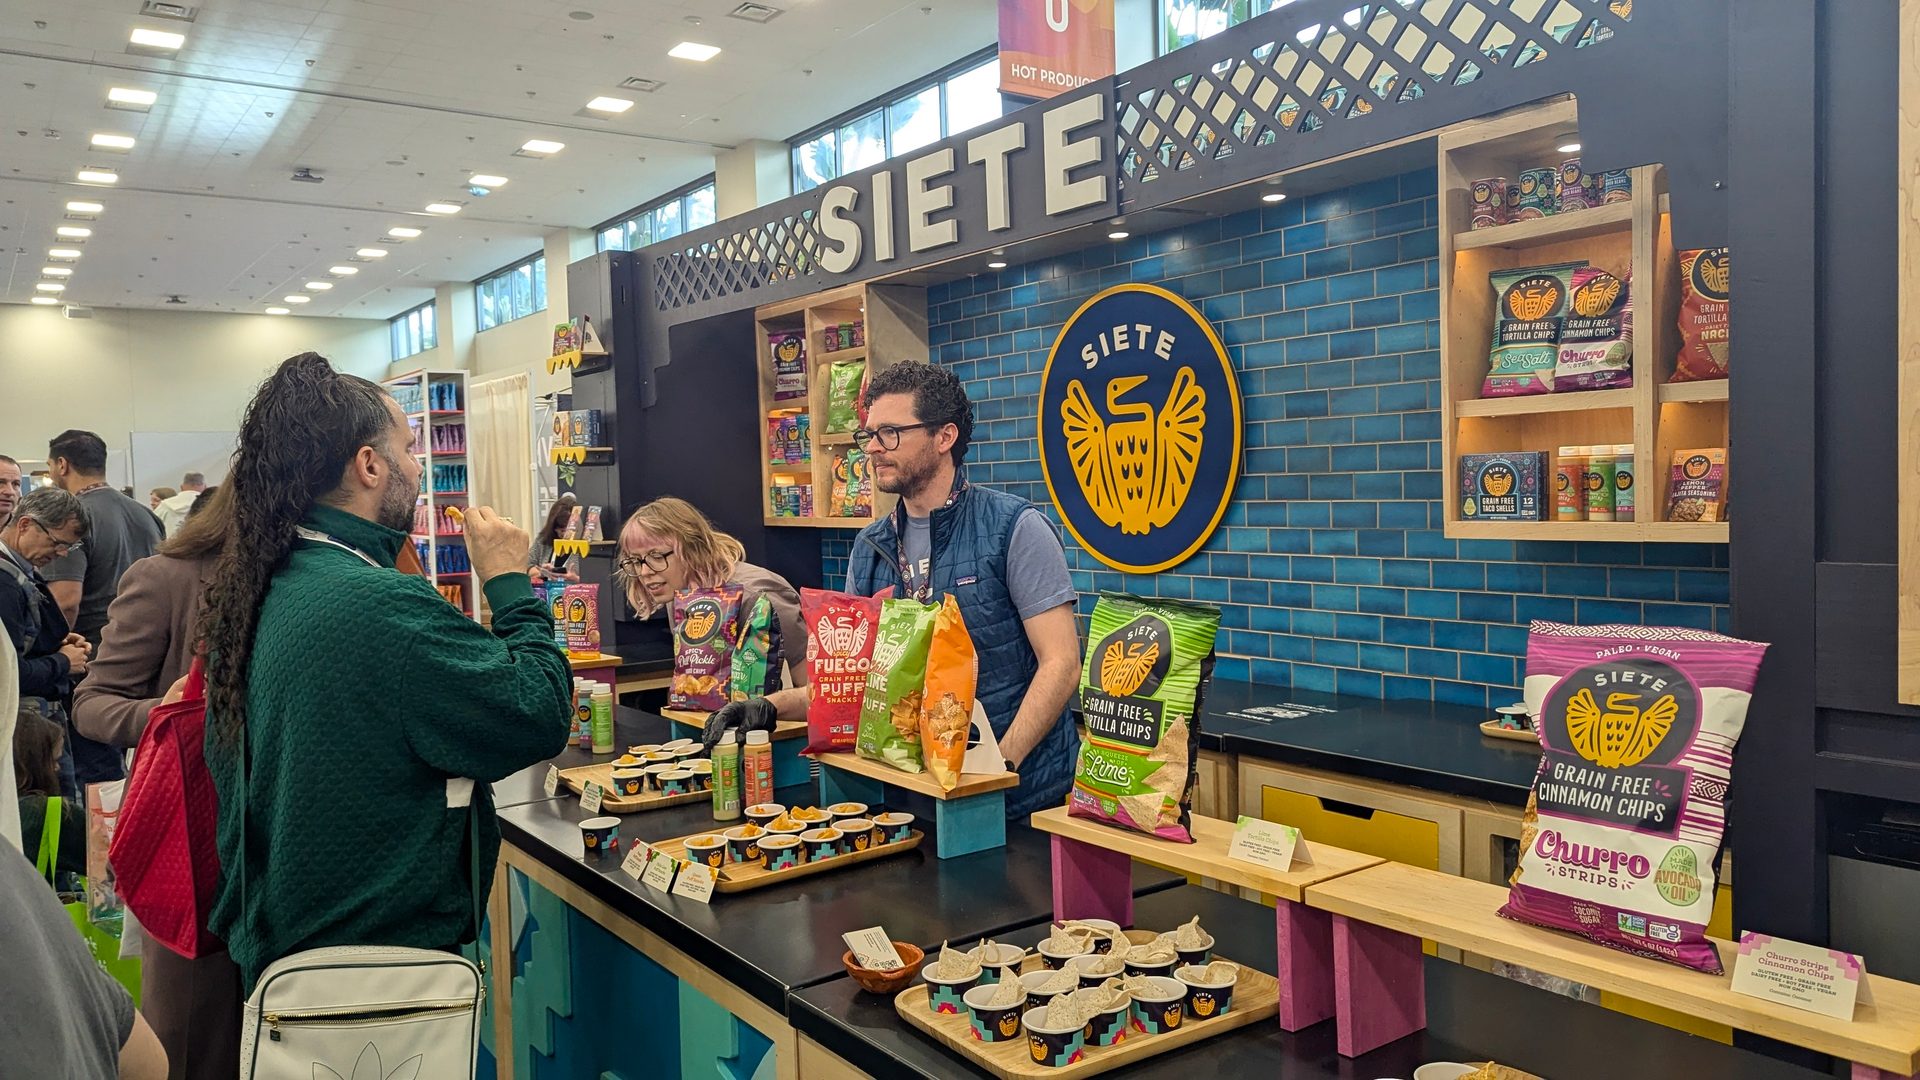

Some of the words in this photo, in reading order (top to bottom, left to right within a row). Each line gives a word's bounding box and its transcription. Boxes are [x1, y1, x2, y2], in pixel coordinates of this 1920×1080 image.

[1011, 63, 1037, 80] HOT
[1040, 69, 1097, 88] PRODUC
[819, 93, 1107, 274] SIETE
[1520, 280, 1551, 288] SIETE
[1700, 304, 1724, 312] GRAIN
[1568, 320, 1590, 328] GRAIN
[1592, 318, 1610, 328] FREE
[1694, 313, 1728, 324] TORTILLA
[1508, 324, 1529, 332] GRAIN
[1532, 322, 1549, 330] FREE
[1562, 329, 1592, 338] CINNAMON
[1594, 328, 1616, 336] CHIPS
[1502, 331, 1531, 342] TORTILLA
[1534, 330, 1555, 339] CHIPS
[1081, 323, 1176, 370] SIETE
[1560, 350, 1606, 364] Churro
[828, 606, 863, 618] STE
[1127, 626, 1158, 641] SIETE
[684, 648, 704, 656] SPICY
[1596, 644, 1633, 659] PALEO
[1644, 645, 1681, 660] VEGAN
[690, 654, 716, 668] Pickle
[814, 658, 871, 674] FUEGO
[820, 682, 866, 697] PUFF
[1594, 671, 1668, 692] SIETE
[1089, 698, 1115, 716] GRAIN
[1118, 702, 1142, 721] FREE
[1086, 713, 1116, 734] ORTILLA
[1120, 720, 1152, 740] CHIPS
[1086, 756, 1130, 786] Lime
[1554, 762, 1607, 788] GRAIN
[1611, 774, 1652, 796] FREE
[1539, 782, 1615, 811] CINNAMON
[1618, 798, 1666, 823] CHIPS
[1534, 829, 1651, 879] Churro
[1669, 856, 1693, 866] MADE
[1670, 864, 1691, 872] WITH
[1558, 866, 1618, 888] STRIPS
[1653, 870, 1702, 892] AVOCADO
[1670, 886, 1686, 902] OIL
[1574, 906, 1601, 918] COCONUT
[1578, 915, 1600, 924] SUGAR
[1650, 926, 1668, 934] GLUTEN
[1758, 957, 1806, 974] Cinnamon
[1807, 968, 1835, 981] Chips
[1766, 951, 1799, 965] Churro
[1800, 957, 1829, 972] Strips
[1751, 972, 1768, 980] DAIRY
[1798, 982, 1812, 990] FREE
[1816, 987, 1837, 996] VEGAN
[1758, 968, 1779, 977] GLUTEN
[1798, 978, 1816, 986] GRAIN
[1816, 982, 1832, 990] FREE
